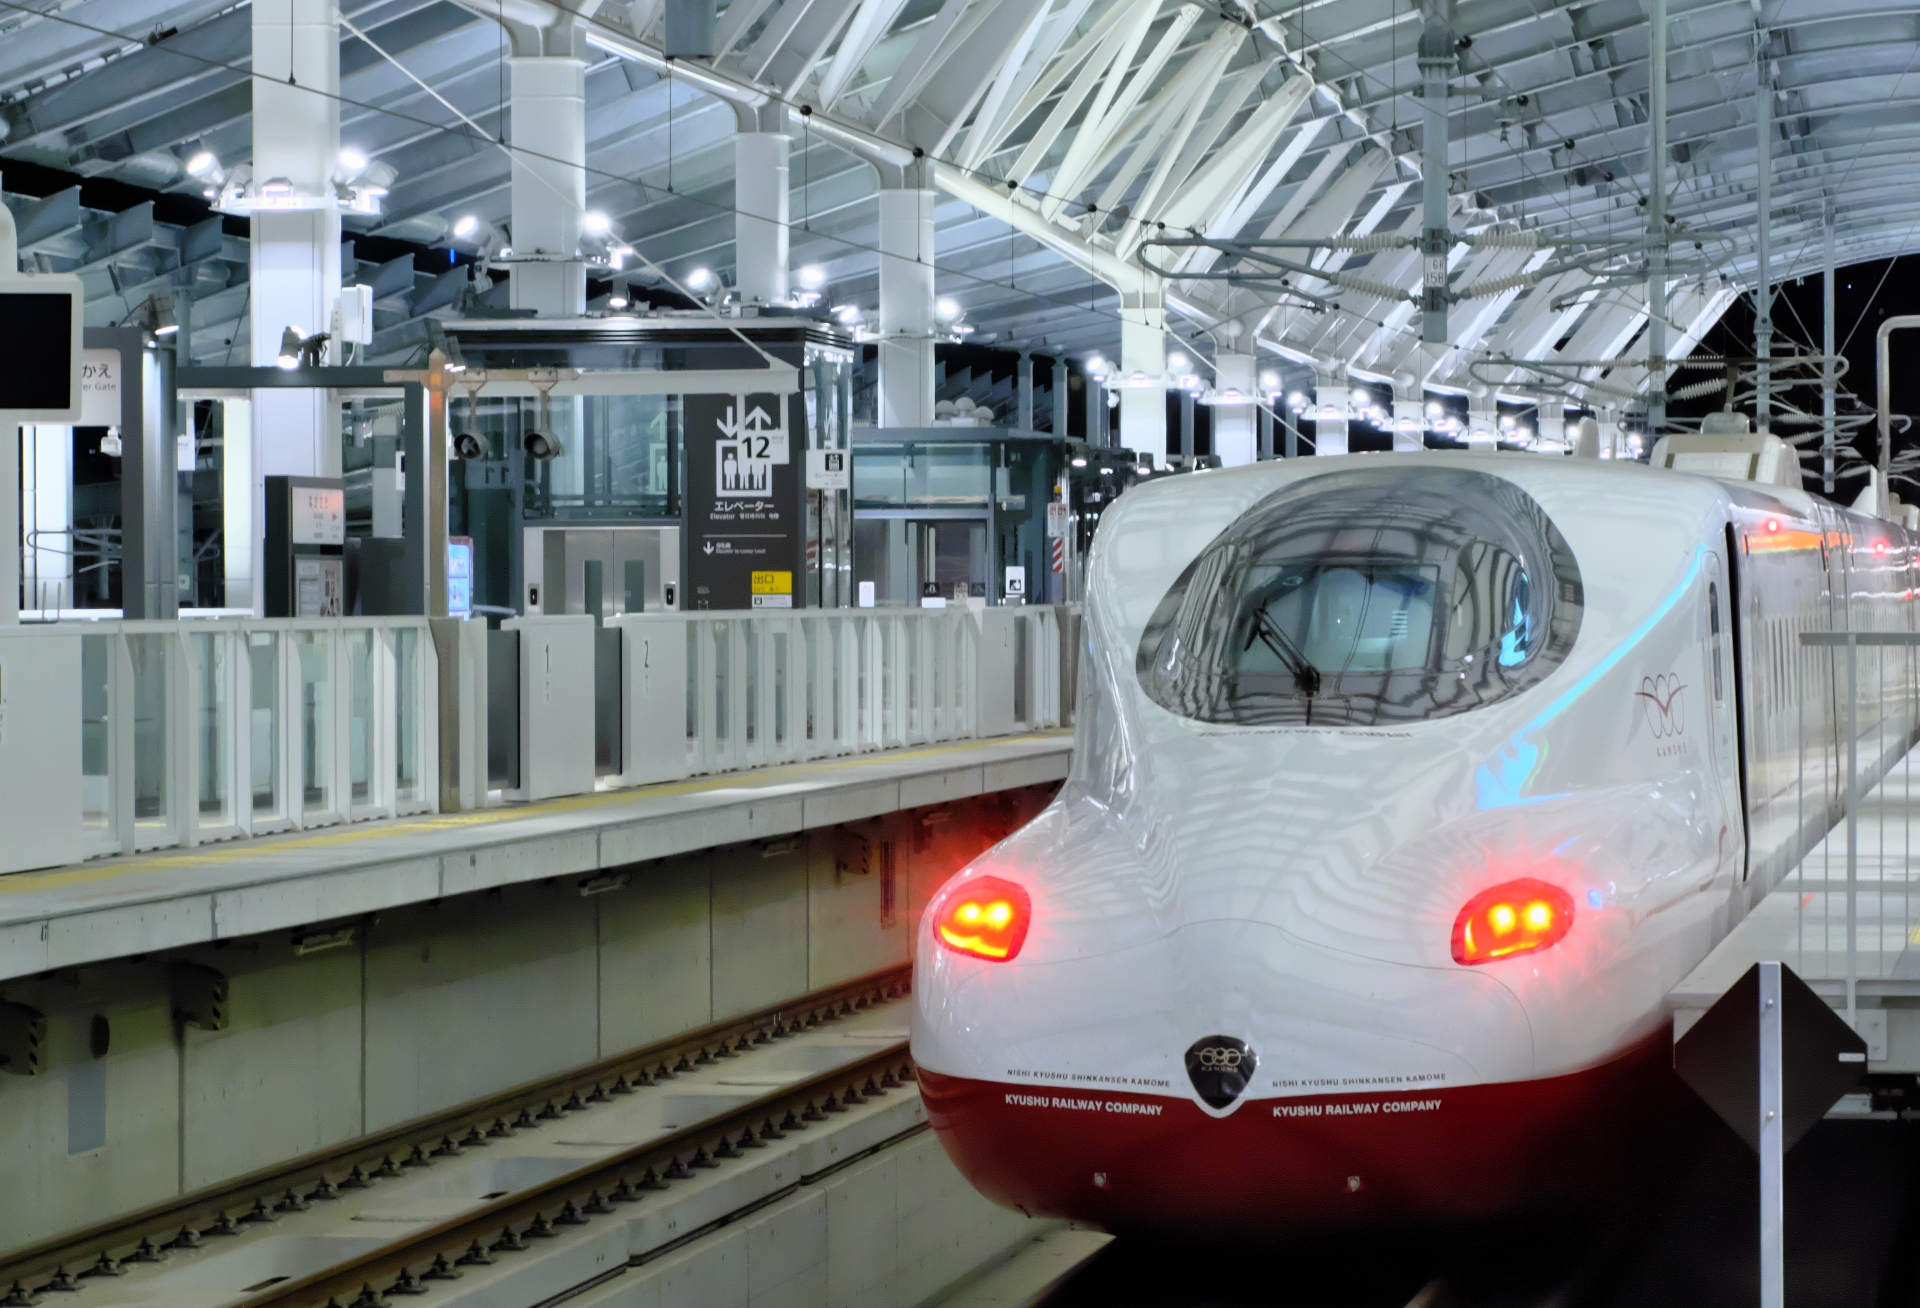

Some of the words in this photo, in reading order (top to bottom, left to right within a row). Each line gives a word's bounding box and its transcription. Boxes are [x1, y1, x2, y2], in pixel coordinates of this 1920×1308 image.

[1426, 272, 1444, 284] 158
[83, 364, 112, 379] かえ
[95, 382, 116, 391] Gate
[742, 436, 771, 459] 12
[714, 500, 775, 512] エレベーター
[710, 512, 735, 520] Elevator
[753, 574, 774, 584] 出口
[1007, 1069, 1031, 1077] NISHI
[1033, 1071, 1069, 1080] KYUSHU
[1071, 1074, 1128, 1084] SHINKANSEN
[1131, 1078, 1170, 1088] KAMOME
[1272, 1080, 1298, 1088] NISHI
[1301, 1079, 1339, 1087] KYUSHU
[1342, 1076, 1403, 1086] SHINKANSEN
[1405, 1073, 1446, 1083] KAMOME
[1005, 1094, 1049, 1107] KYUSHU
[1052, 1097, 1102, 1111] RAILWAY
[1105, 1101, 1163, 1116] COMPANY
[1272, 1105, 1322, 1117] KYUSHU
[1325, 1102, 1380, 1116] RAILWAY
[1382, 1099, 1442, 1113] COMPANY
